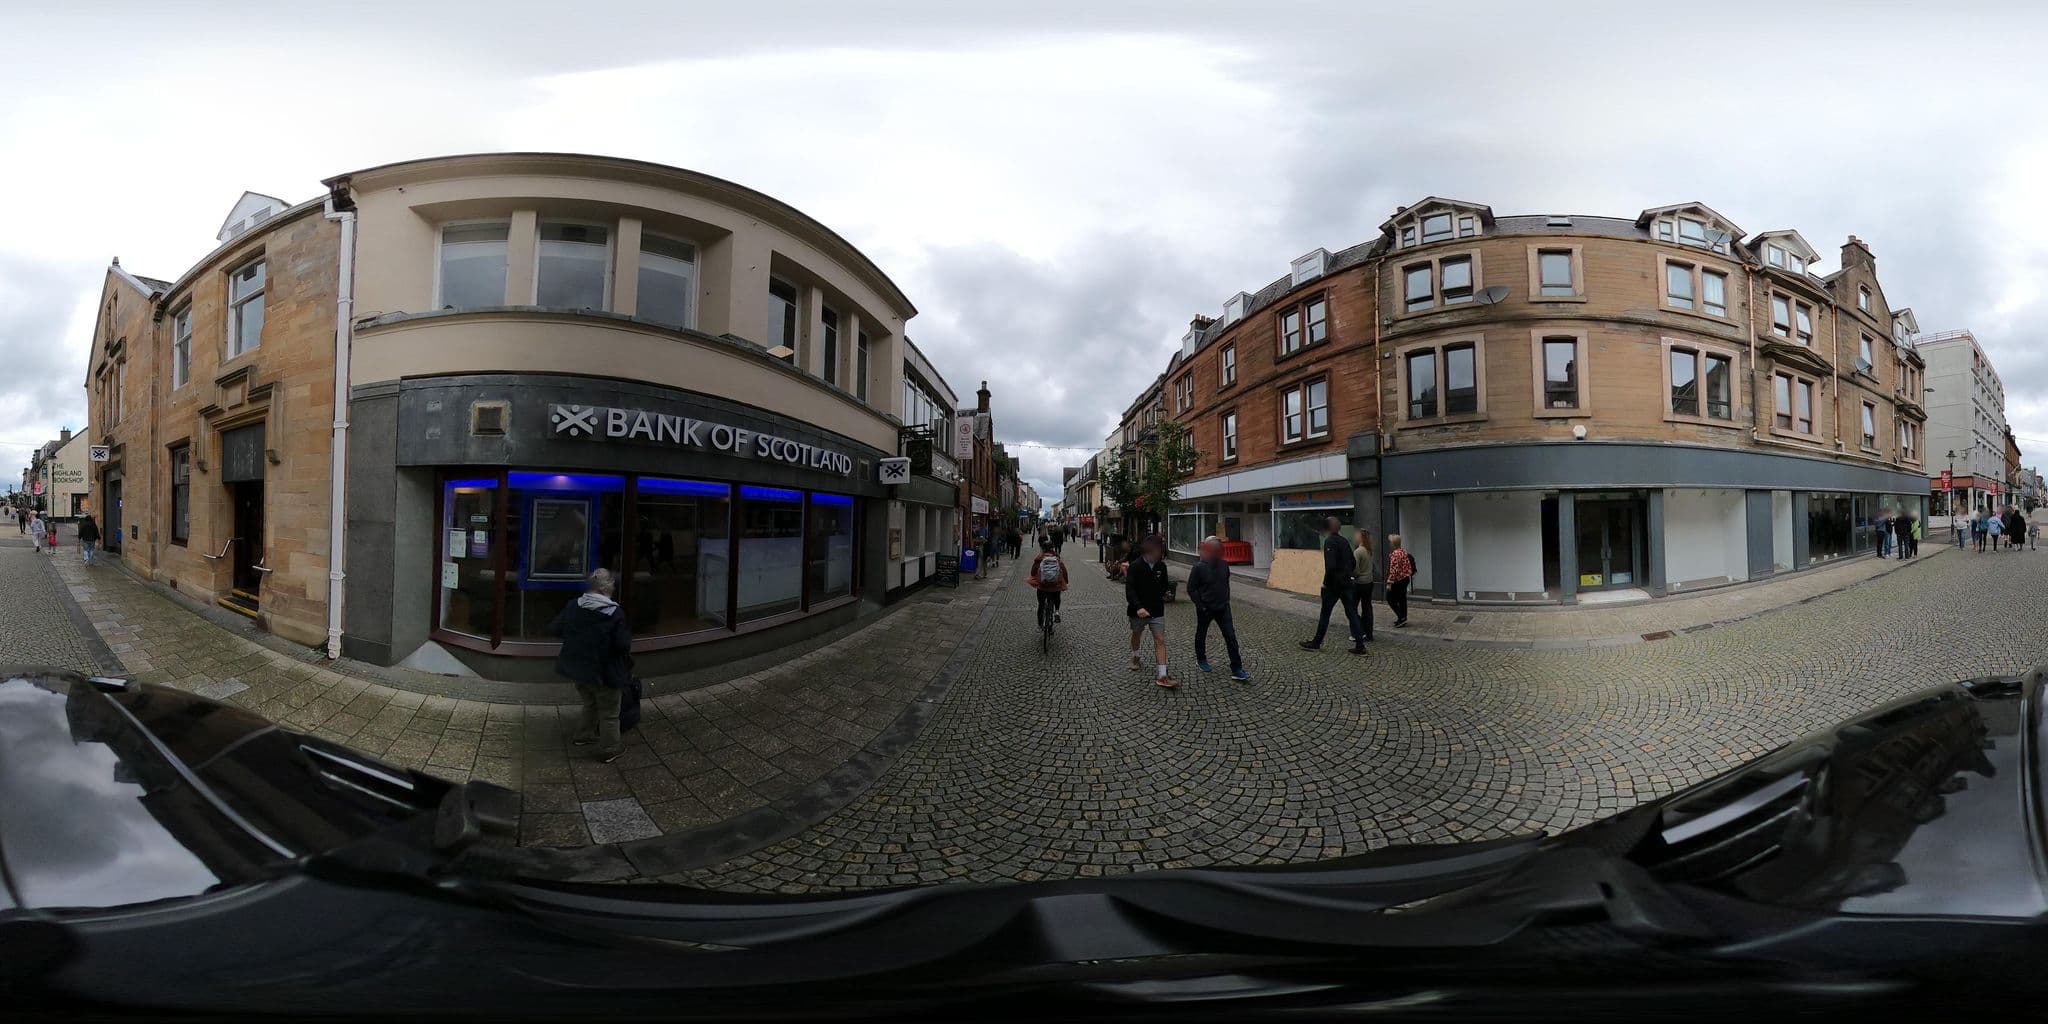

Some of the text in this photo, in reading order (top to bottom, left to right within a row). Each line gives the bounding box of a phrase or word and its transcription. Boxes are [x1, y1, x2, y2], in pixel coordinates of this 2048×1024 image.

[607, 408, 852, 474] BANK OF SCOTLAND
